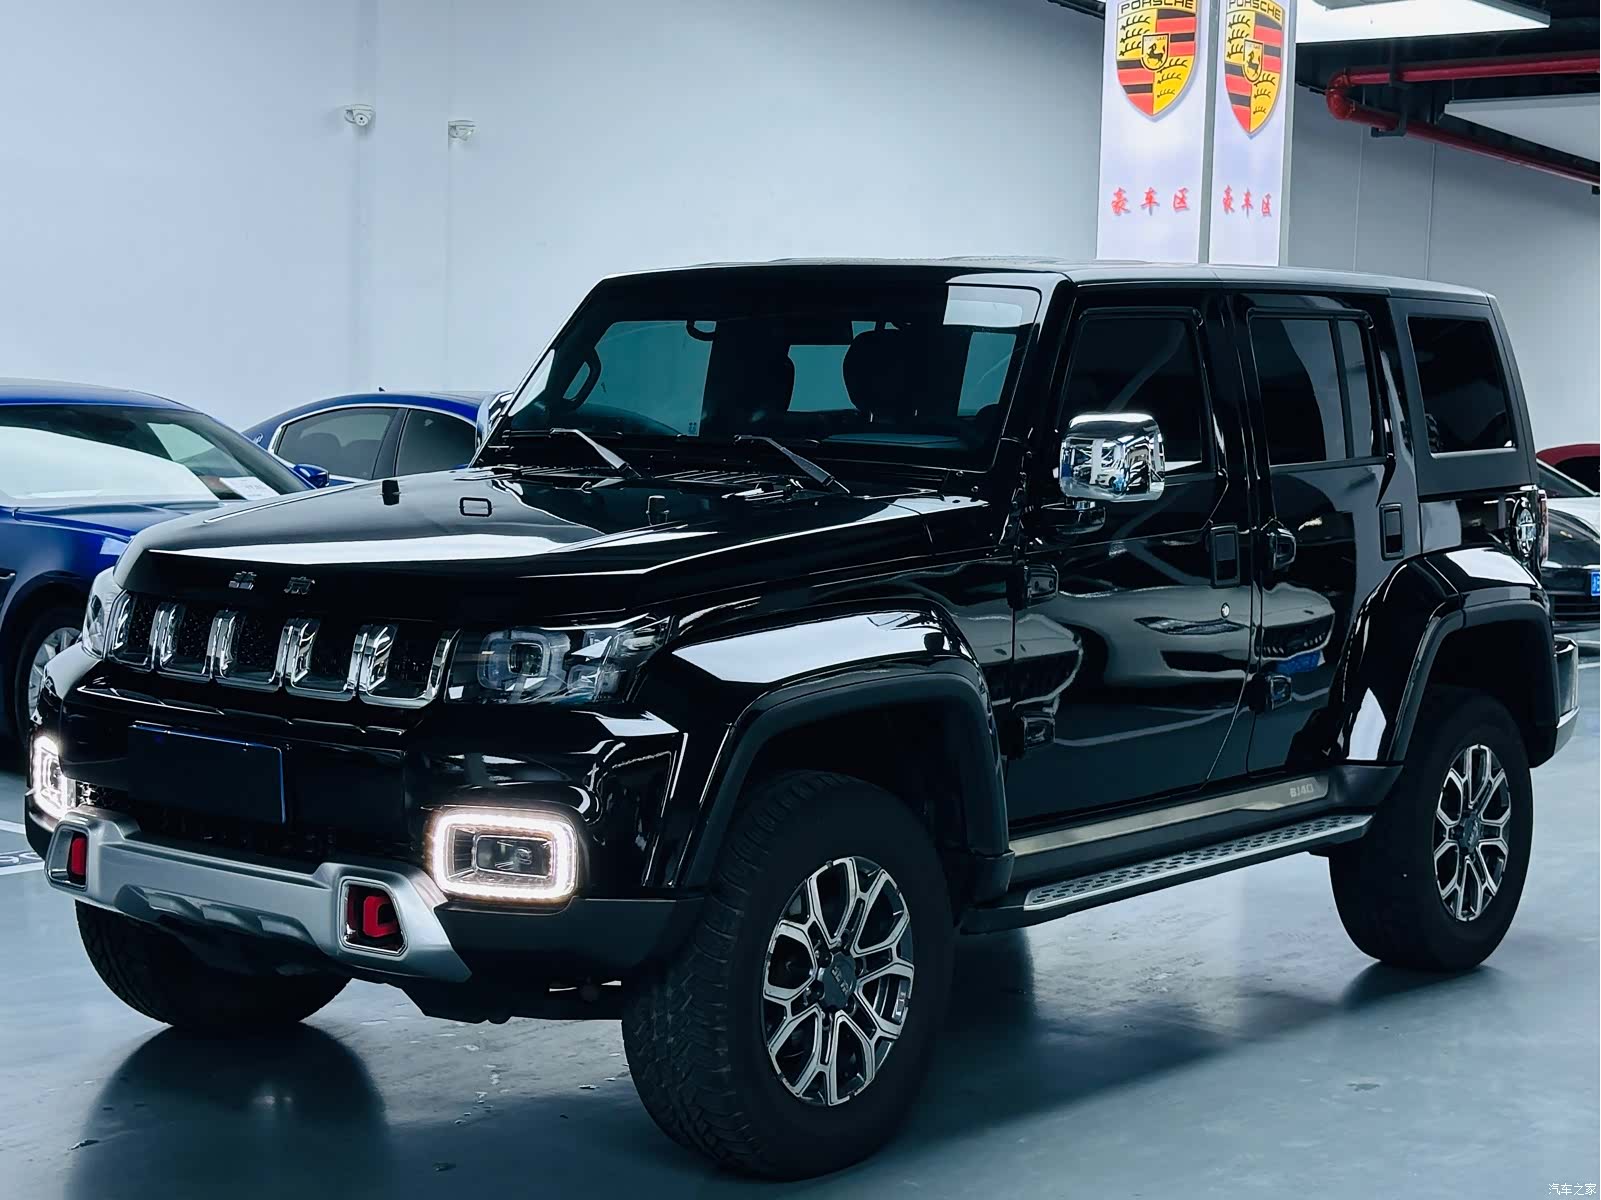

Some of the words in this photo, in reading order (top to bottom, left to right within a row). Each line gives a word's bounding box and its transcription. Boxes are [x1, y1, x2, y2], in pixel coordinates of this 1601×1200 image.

[1121, 0, 1193, 14] PORSCHE
[1229, 0, 1281, 21] PORSCHE
[1111, 187, 1190, 216] 豪车区
[228, 570, 316, 596] 北京
[1289, 783, 1314, 798] BJ40
